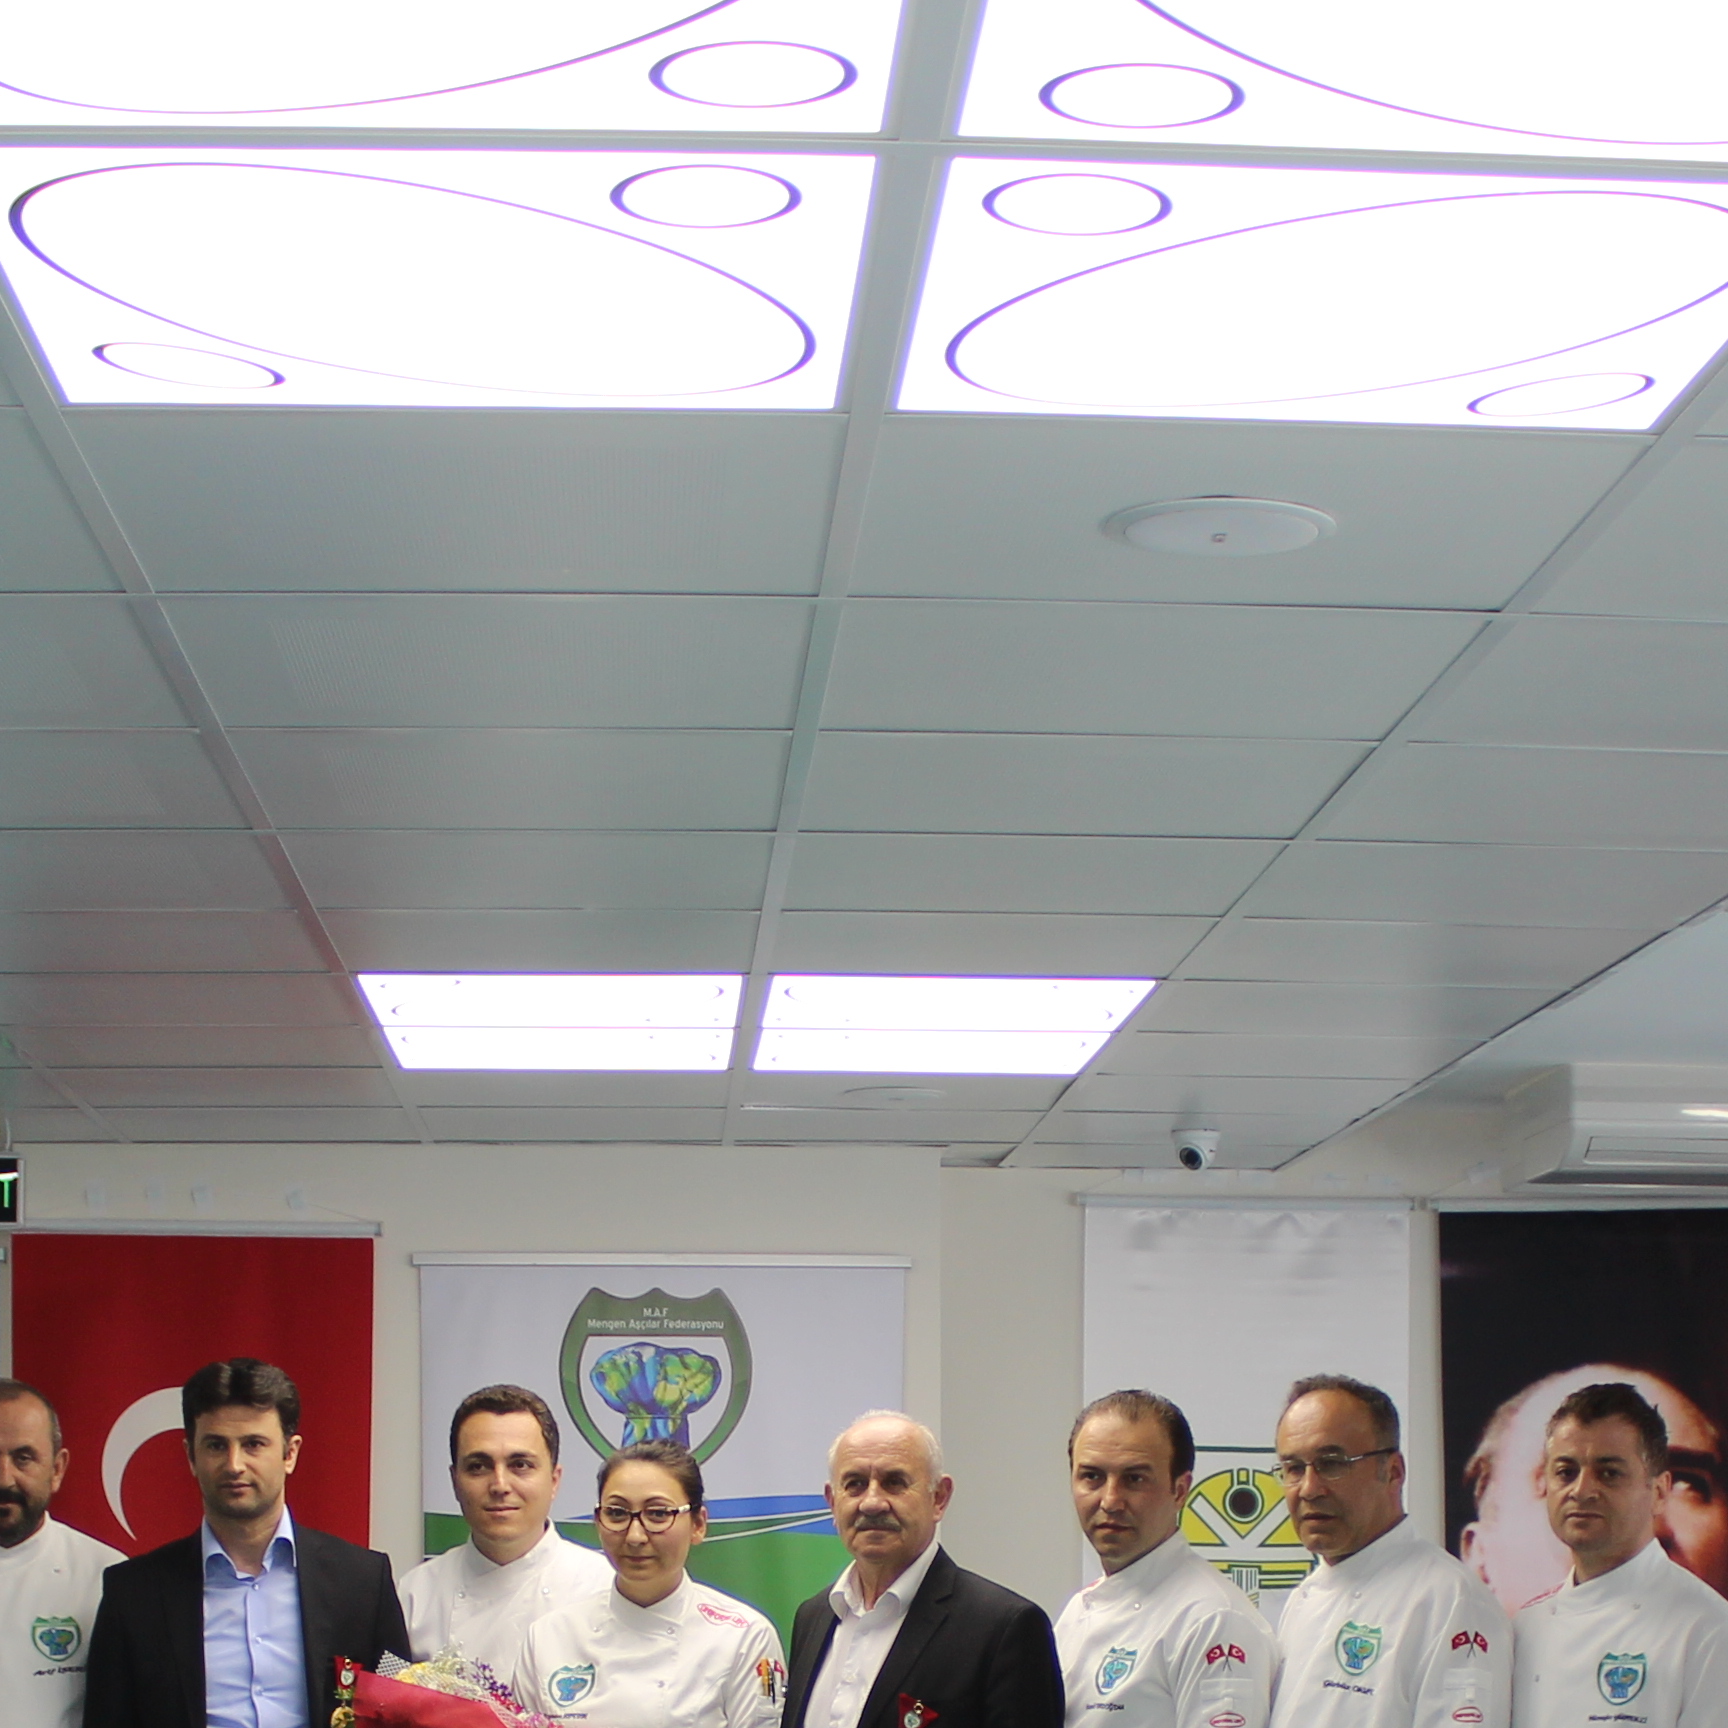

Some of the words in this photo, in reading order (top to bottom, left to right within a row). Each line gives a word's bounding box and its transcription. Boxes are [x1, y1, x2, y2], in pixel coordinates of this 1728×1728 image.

[587, 1319, 626, 1330] Mengen
[629, 1319, 660, 1330] Aşçılar
[663, 1319, 724, 1331] Federasyonu
